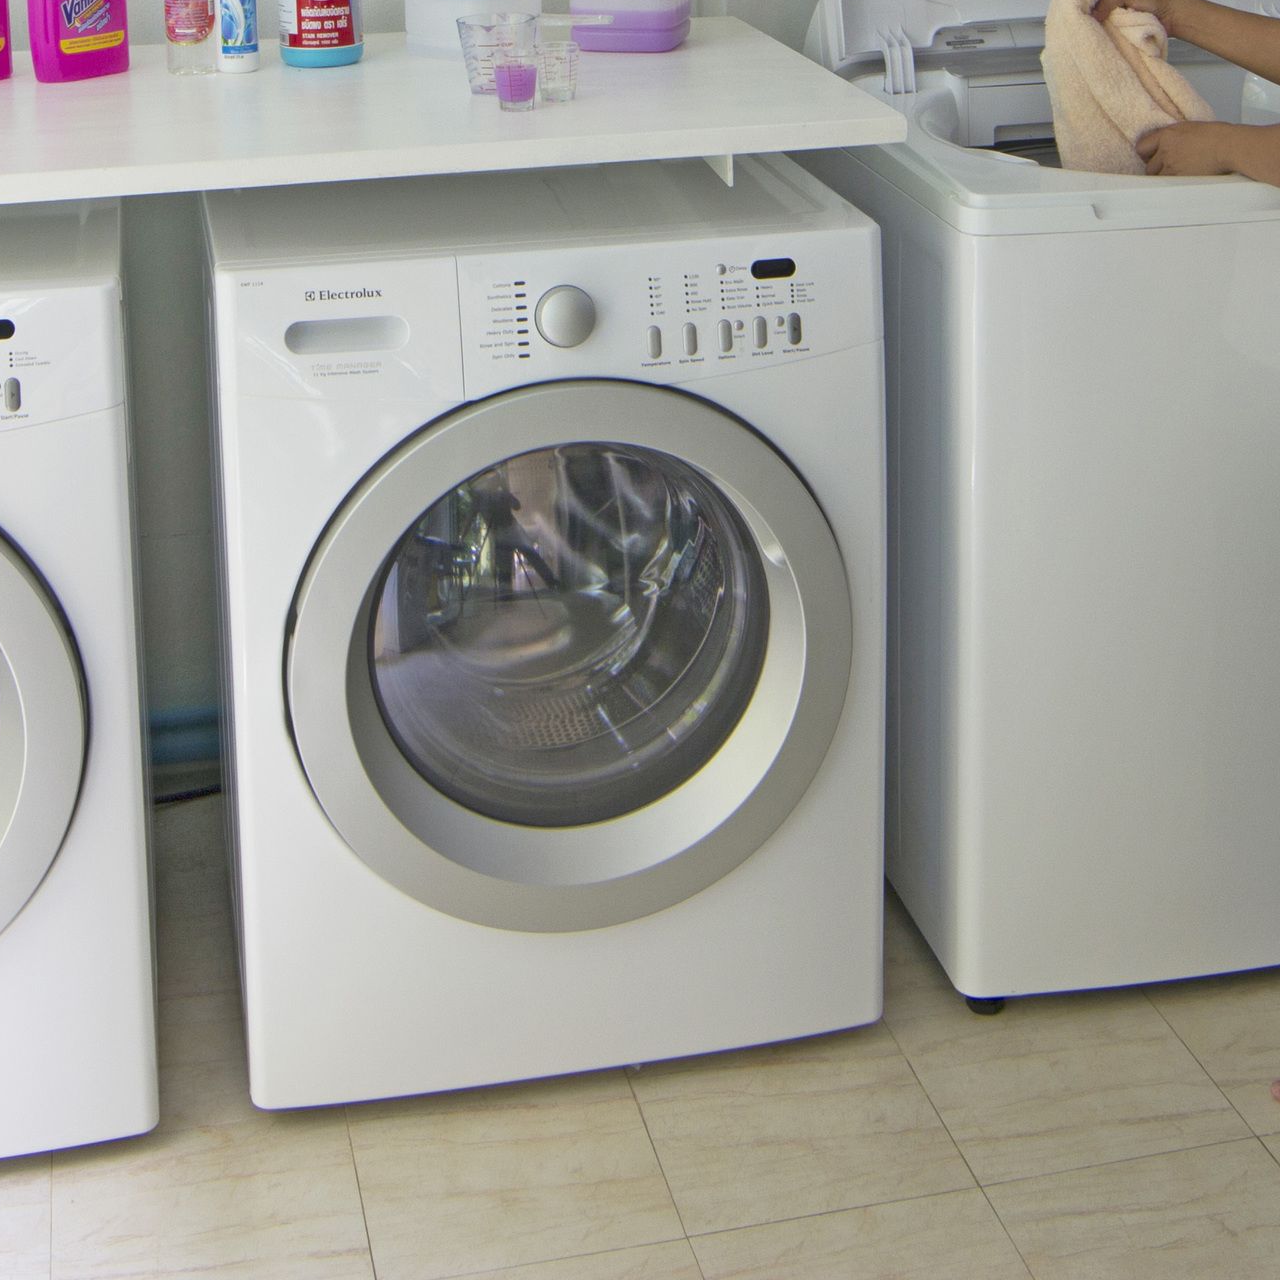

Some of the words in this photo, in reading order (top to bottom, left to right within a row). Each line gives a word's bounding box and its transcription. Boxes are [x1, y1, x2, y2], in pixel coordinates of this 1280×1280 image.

[319, 288, 383, 301] Electrolux
[641, 360, 672, 368] Temperature
[0, 412, 29, 421] Start/Pause
